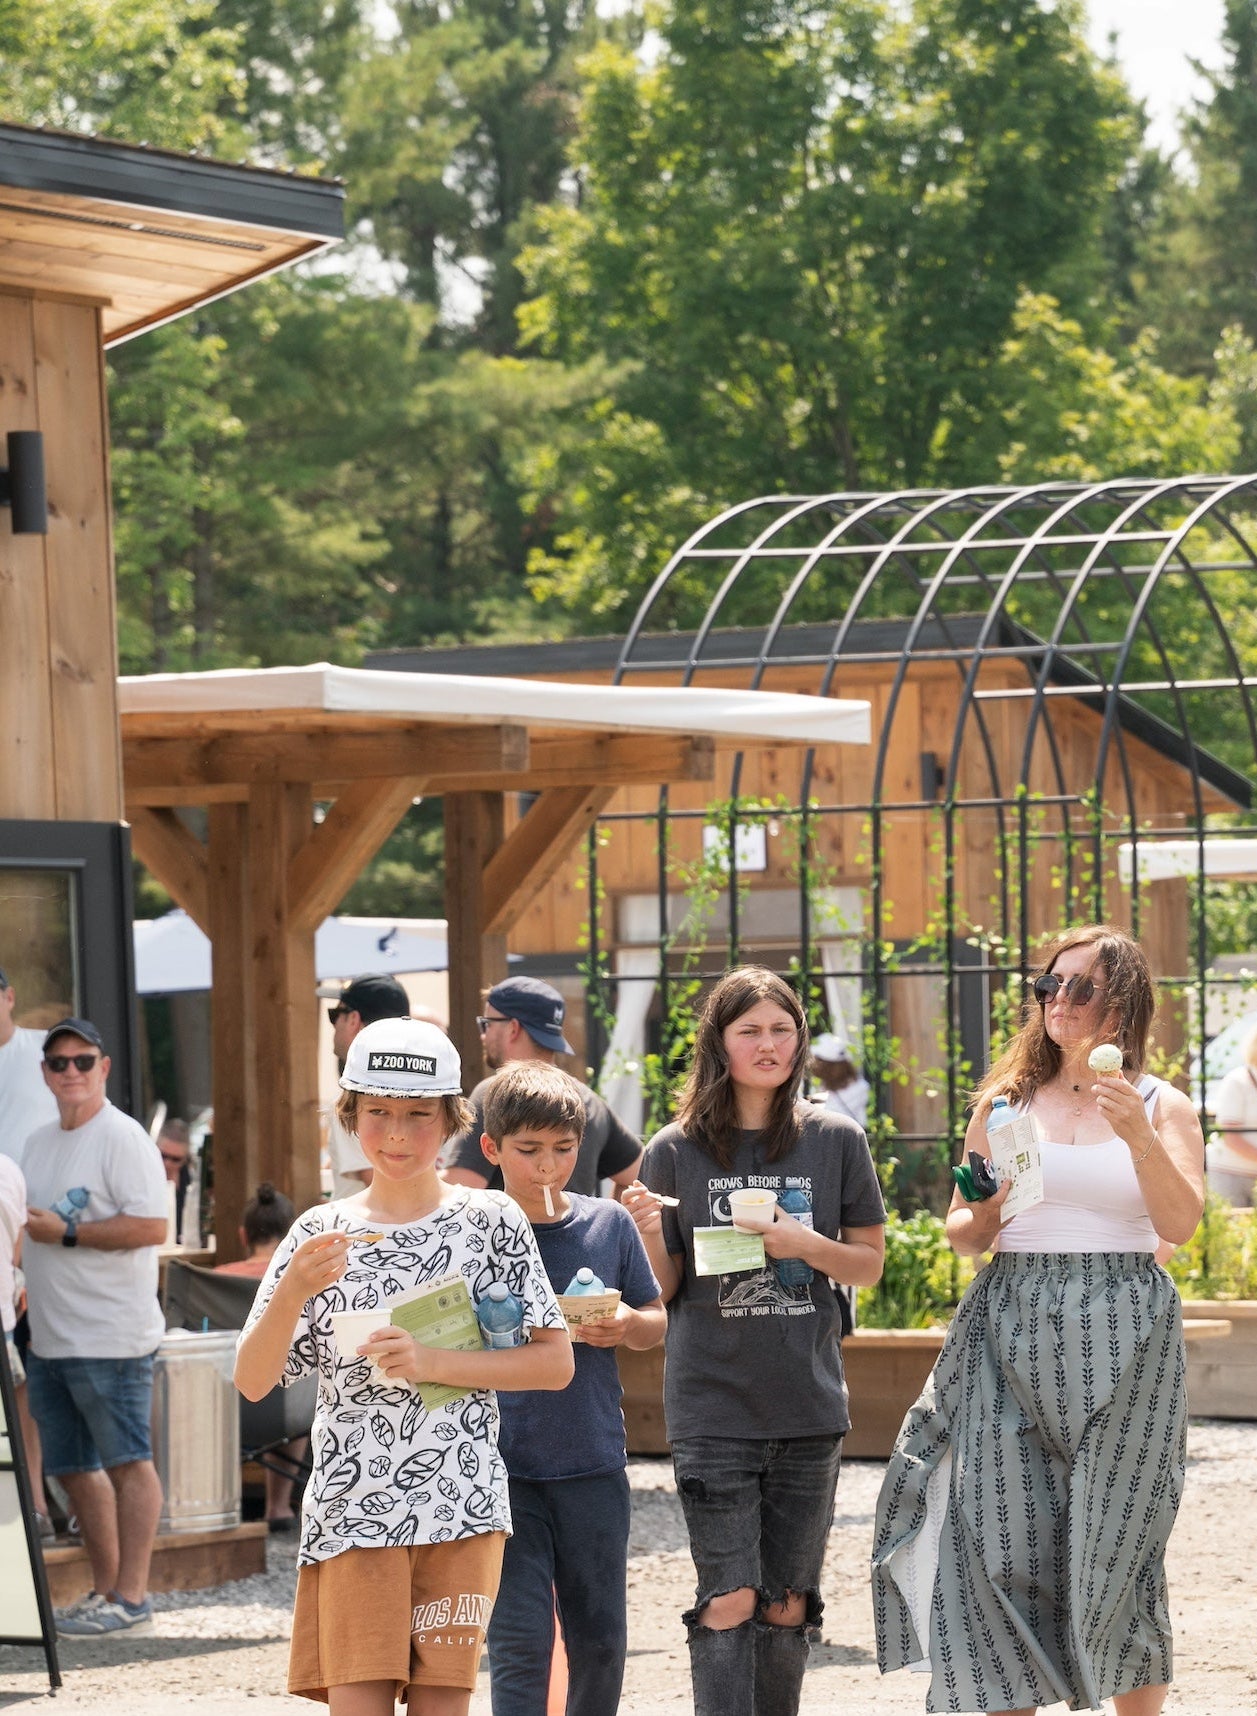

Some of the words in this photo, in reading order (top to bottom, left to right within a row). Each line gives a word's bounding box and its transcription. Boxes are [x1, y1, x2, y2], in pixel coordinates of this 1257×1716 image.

[383, 1055, 405, 1068] ZOO
[406, 1056, 433, 1073] YORK
[708, 1176, 743, 1191] CROWS
[747, 1175, 782, 1189] BEFORE
[750, 1306, 770, 1316] YOUR
[411, 1596, 452, 1635] LOS
[418, 1634, 476, 1646] CALIF
